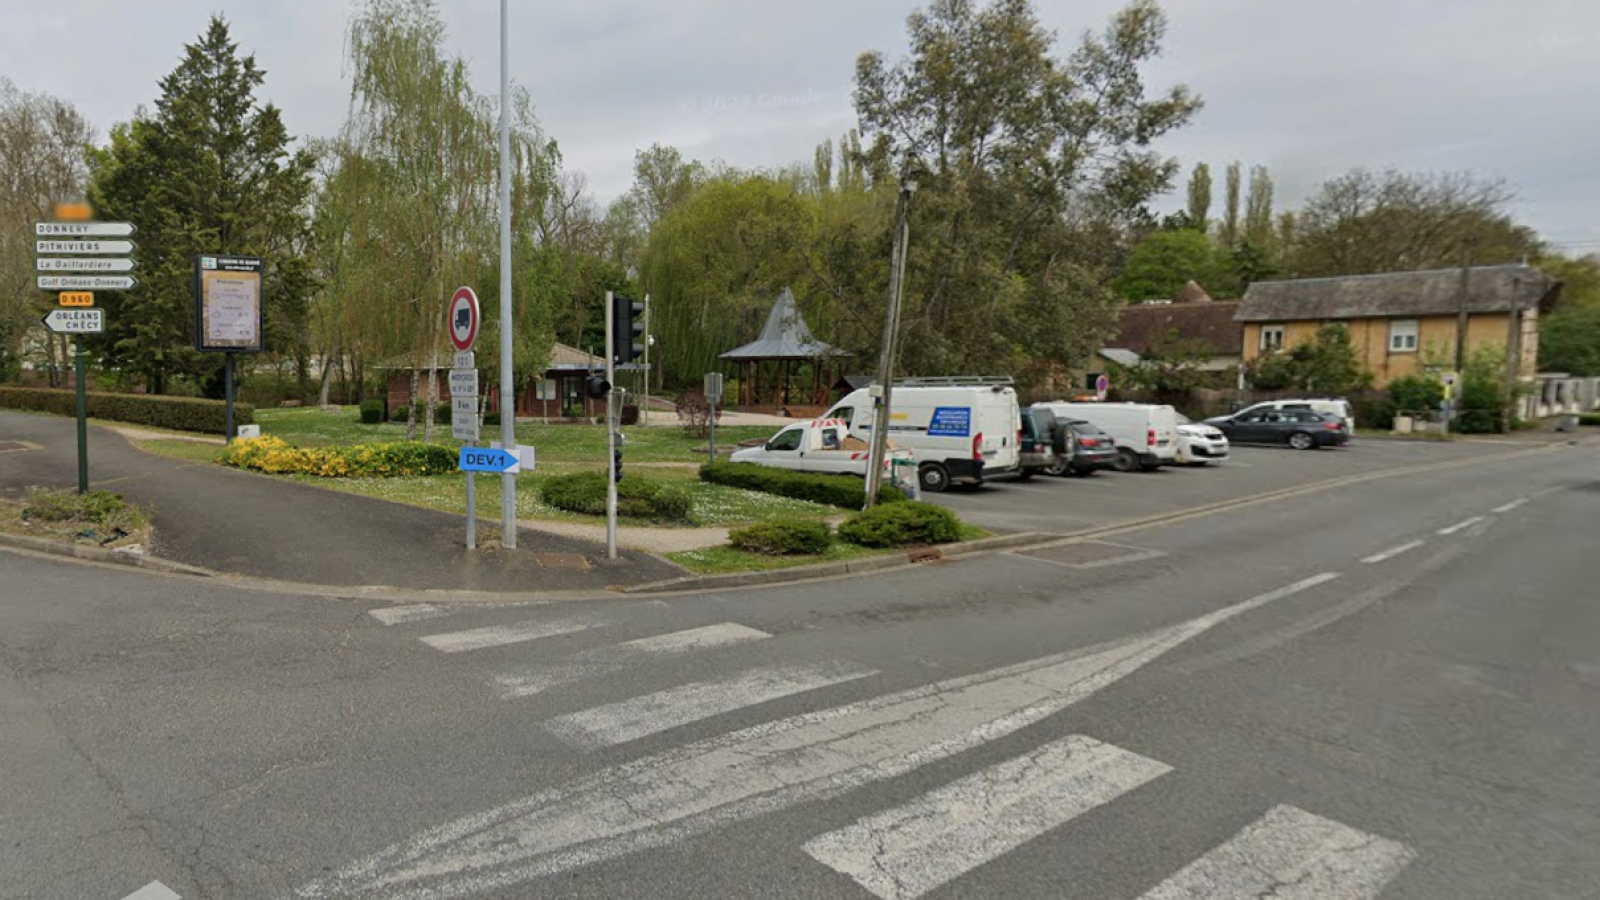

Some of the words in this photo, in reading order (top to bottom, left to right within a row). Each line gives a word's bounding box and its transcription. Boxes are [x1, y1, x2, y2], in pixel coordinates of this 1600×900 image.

[39, 225, 88, 233] DONNERY
[39, 242, 100, 251] PITHIVIERS
[40, 260, 51, 269] La
[40, 277, 59, 287] Golf
[61, 294, 67, 304] D
[71, 294, 91, 304] 960
[56, 310, 99, 320] ORLÉANS
[65, 320, 99, 329] CHÉCY
[466, 453, 505, 468] DEV.1
